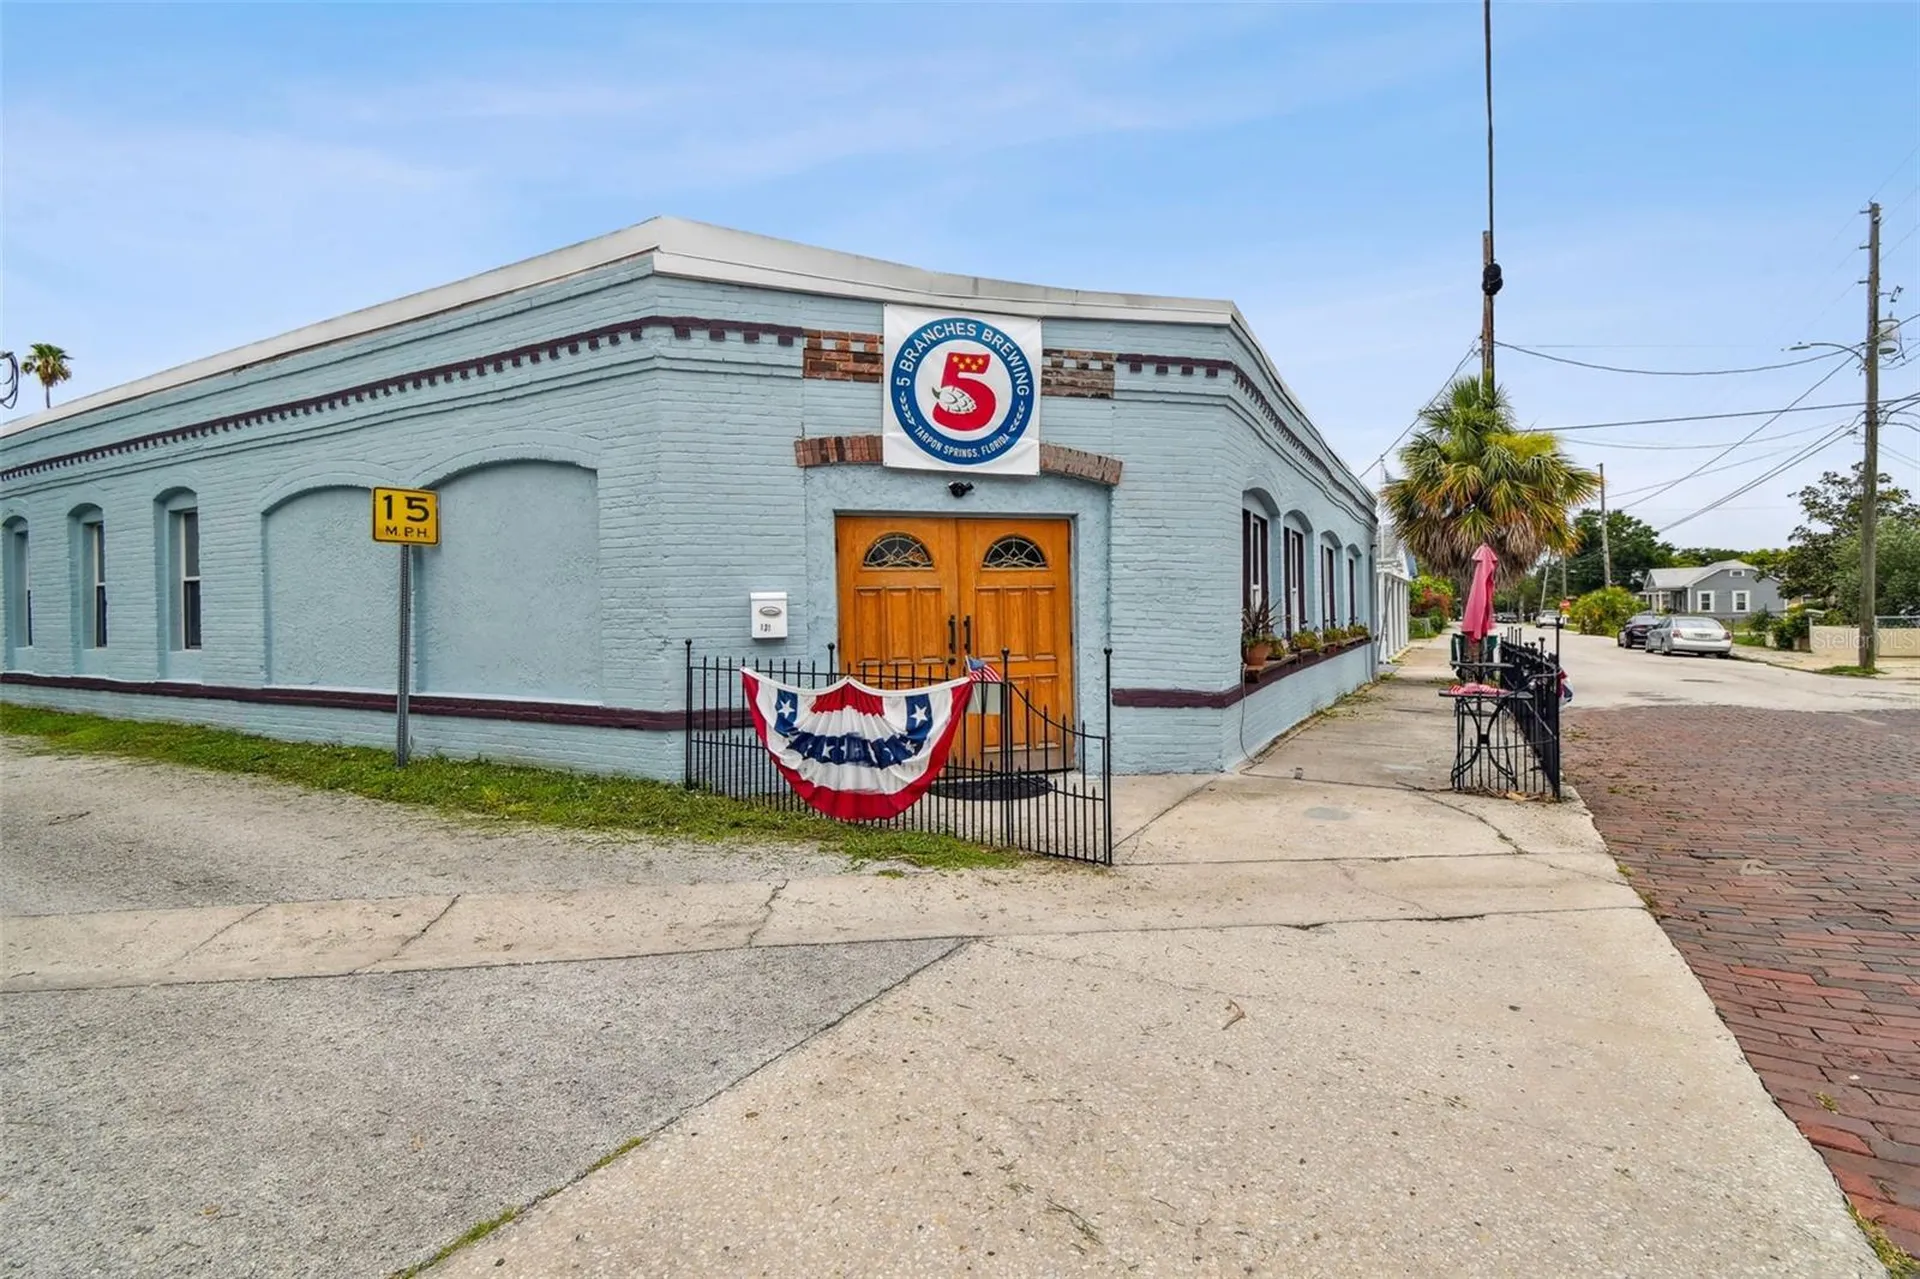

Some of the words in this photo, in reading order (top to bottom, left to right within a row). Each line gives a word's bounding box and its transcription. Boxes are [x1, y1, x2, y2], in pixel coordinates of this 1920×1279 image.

[899, 322, 977, 373] BRANCHES
[981, 328, 1030, 396] BREWING
[896, 377, 911, 387] 5
[932, 352, 996, 432] 5
[914, 425, 943, 452] TARPON
[981, 433, 1010, 456] FLORIDA
[383, 495, 429, 522] 15
